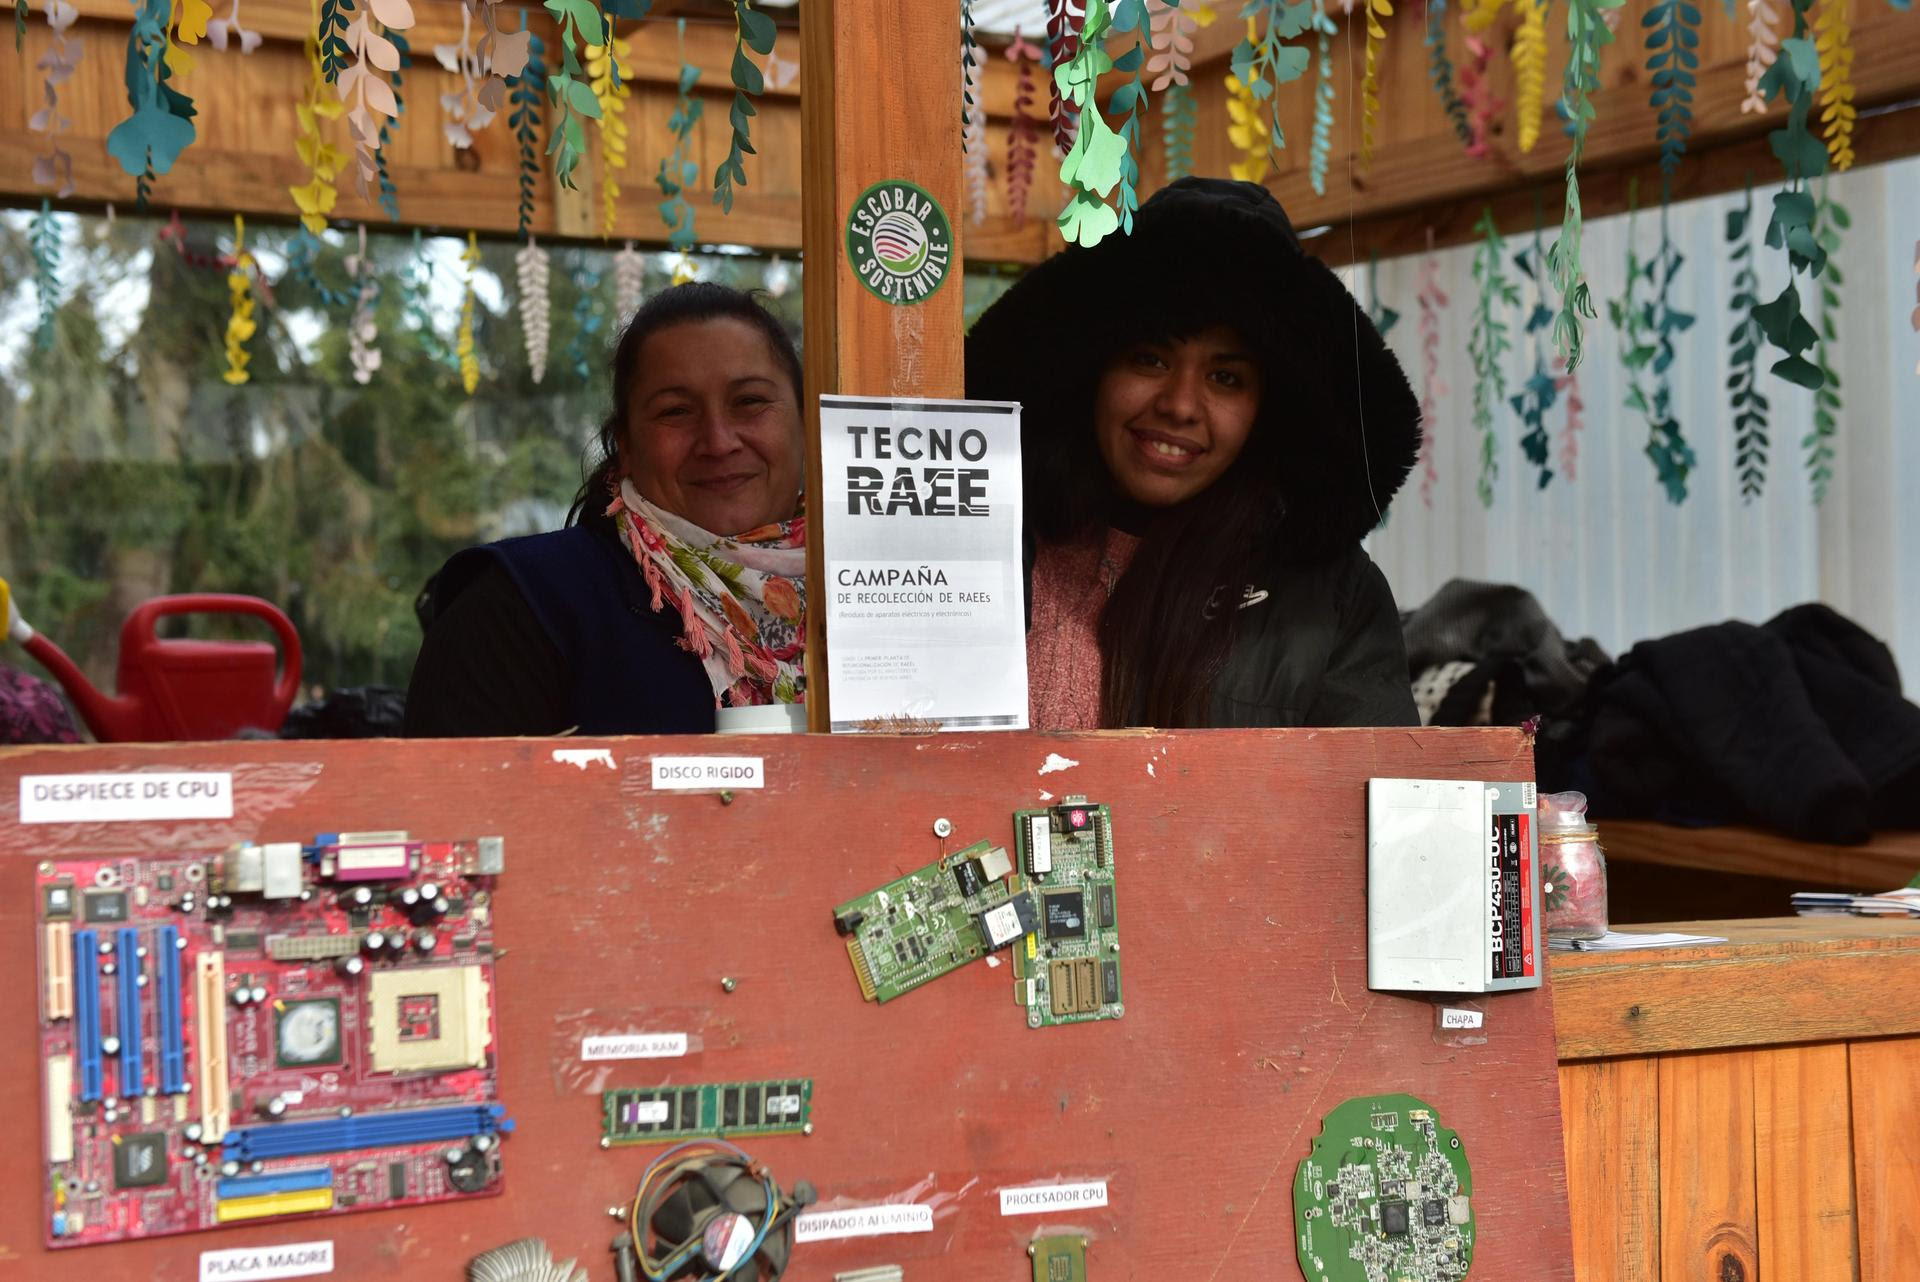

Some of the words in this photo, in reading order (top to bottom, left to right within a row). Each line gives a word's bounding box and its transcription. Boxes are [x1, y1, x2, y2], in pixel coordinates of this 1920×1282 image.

[851, 187, 932, 237] ESCOBAR
[859, 242, 948, 300] SOSTENIBLE
[847, 426, 987, 462] TECNO
[847, 466, 990, 516] RAEE
[838, 566, 948, 586] CAMPAÑA
[838, 593, 852, 604] DE
[858, 590, 934, 604] RECOLECCIÓN
[939, 592, 953, 603] DE
[959, 592, 991, 603] RAEEs
[659, 766, 702, 779] DISCO
[707, 766, 754, 779] RIGIDO
[34, 782, 135, 801] DESPIECE
[143, 781, 169, 798] DE
[177, 781, 219, 798] CPU
[1446, 1014, 1474, 1025] CHAPA
[588, 1043, 648, 1055] MEMORIA
[652, 1041, 679, 1051] RAM
[1006, 1190, 1079, 1206] PROCESADOR
[1083, 1187, 1104, 1200] CPU
[207, 1256, 262, 1274] PLACA
[267, 1248, 328, 1267] MADRE
